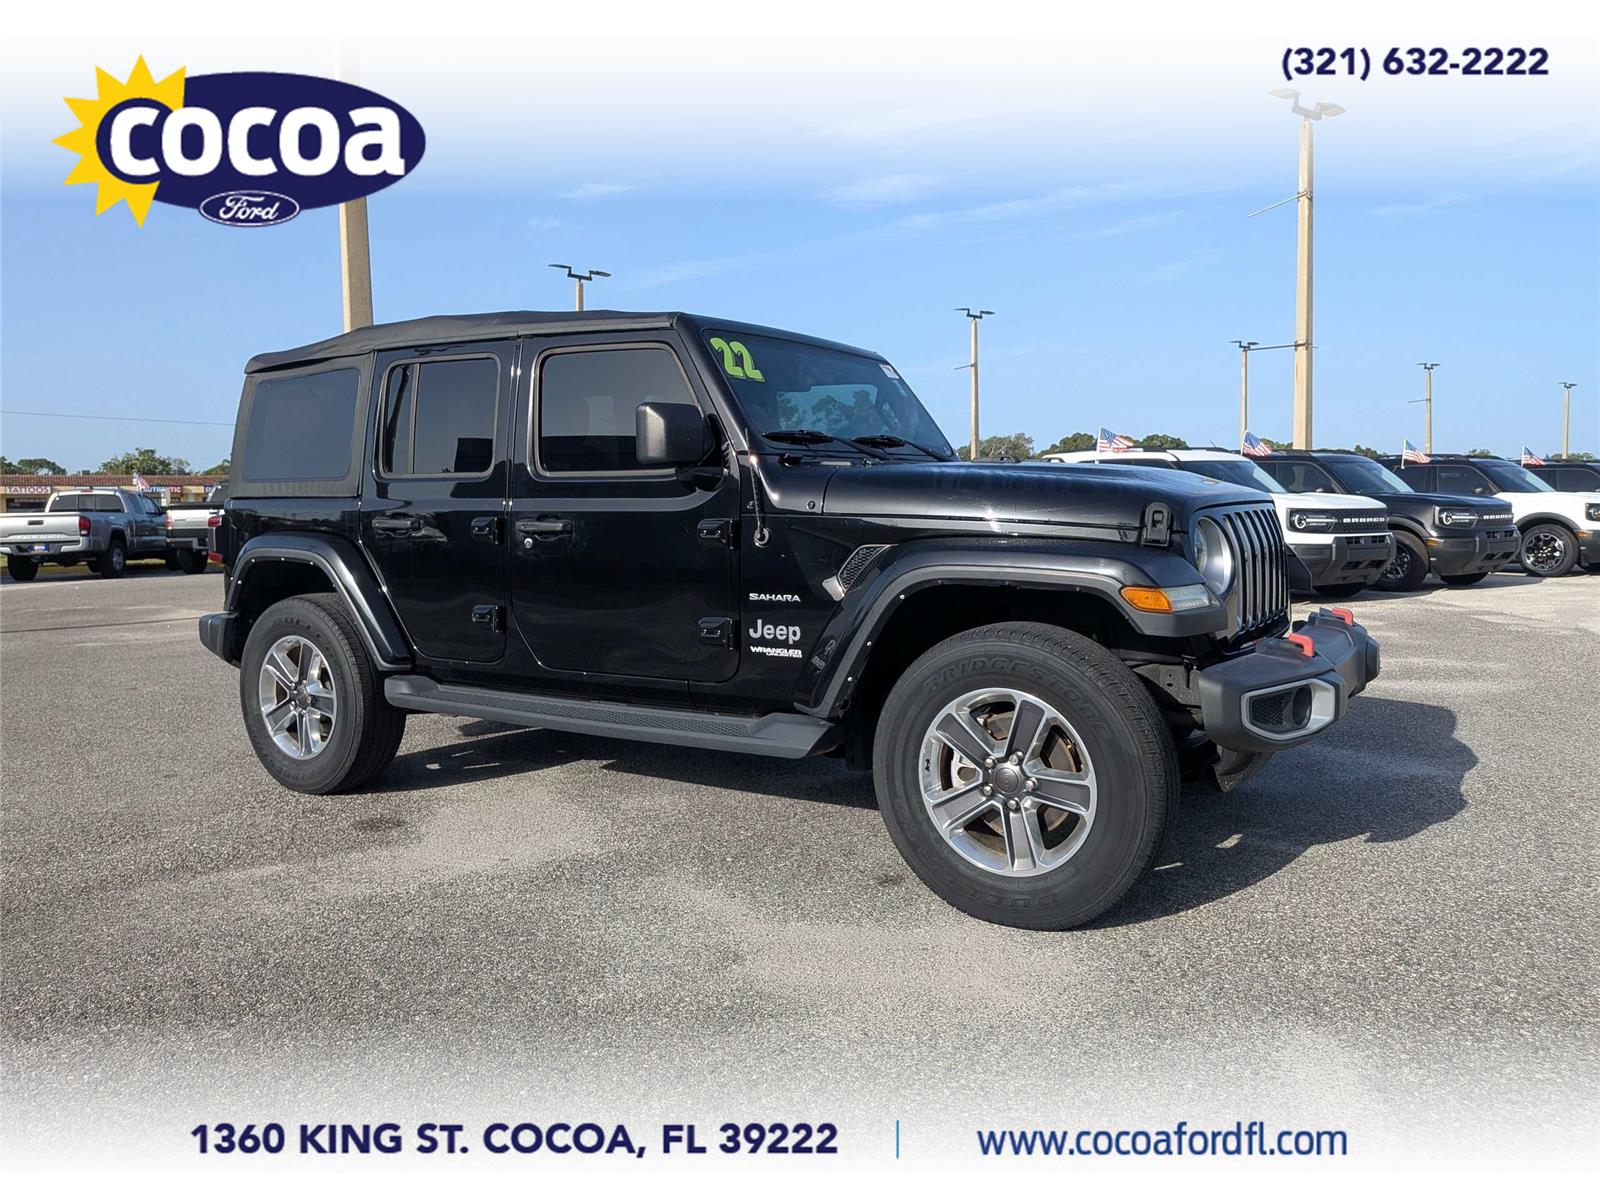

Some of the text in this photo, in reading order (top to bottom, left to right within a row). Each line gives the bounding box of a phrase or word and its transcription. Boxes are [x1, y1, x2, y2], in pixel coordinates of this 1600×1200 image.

[709, 336, 765, 382] 22
[749, 593, 801, 602] SAHARA
[749, 619, 801, 645] Jeep
[750, 646, 802, 655] WRANGLER
